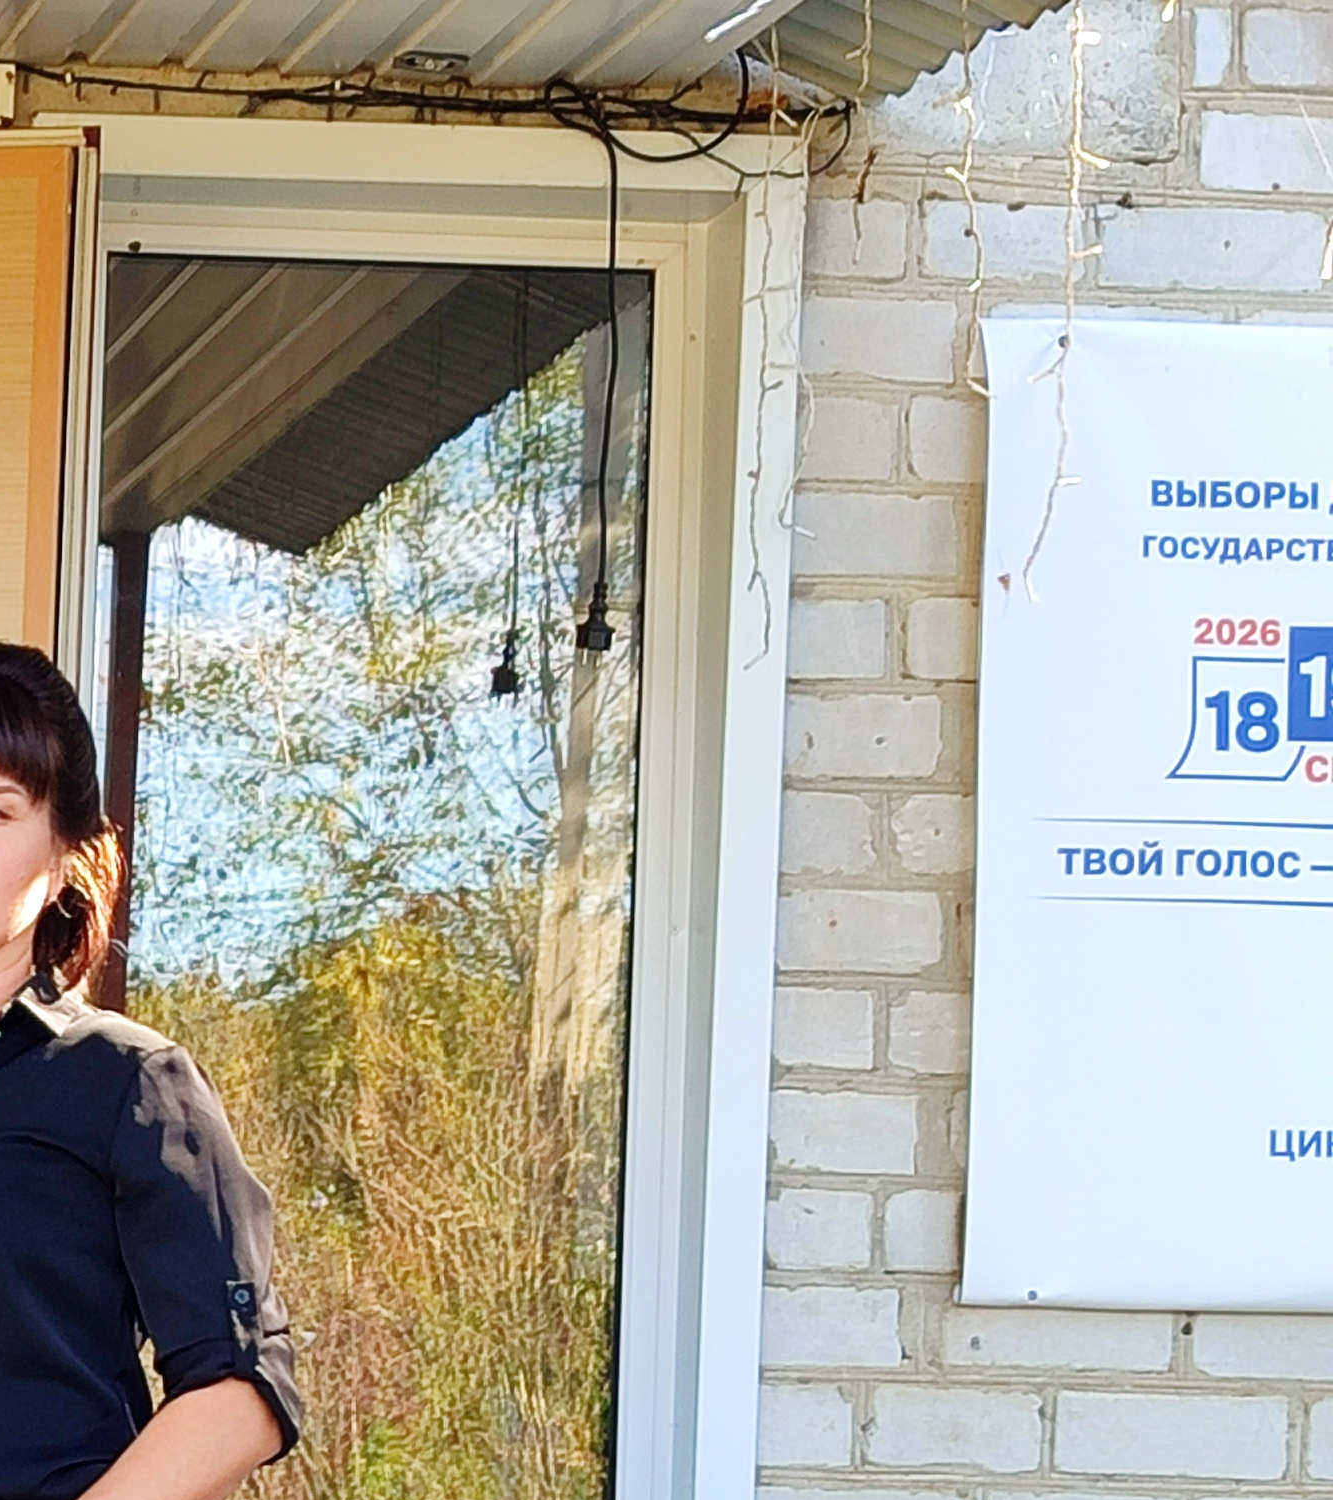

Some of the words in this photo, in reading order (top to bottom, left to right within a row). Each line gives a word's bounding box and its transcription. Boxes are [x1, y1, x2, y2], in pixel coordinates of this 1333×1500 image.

[1150, 480, 1320, 510] ВЫБОРЫ
[1193, 617, 1282, 646] 2026
[1299, 653, 1333, 720] 1
[1205, 690, 1280, 753] 18
[1056, 840, 1164, 876] ТВОЙ
[1175, 848, 1302, 878] ГОЛОС
